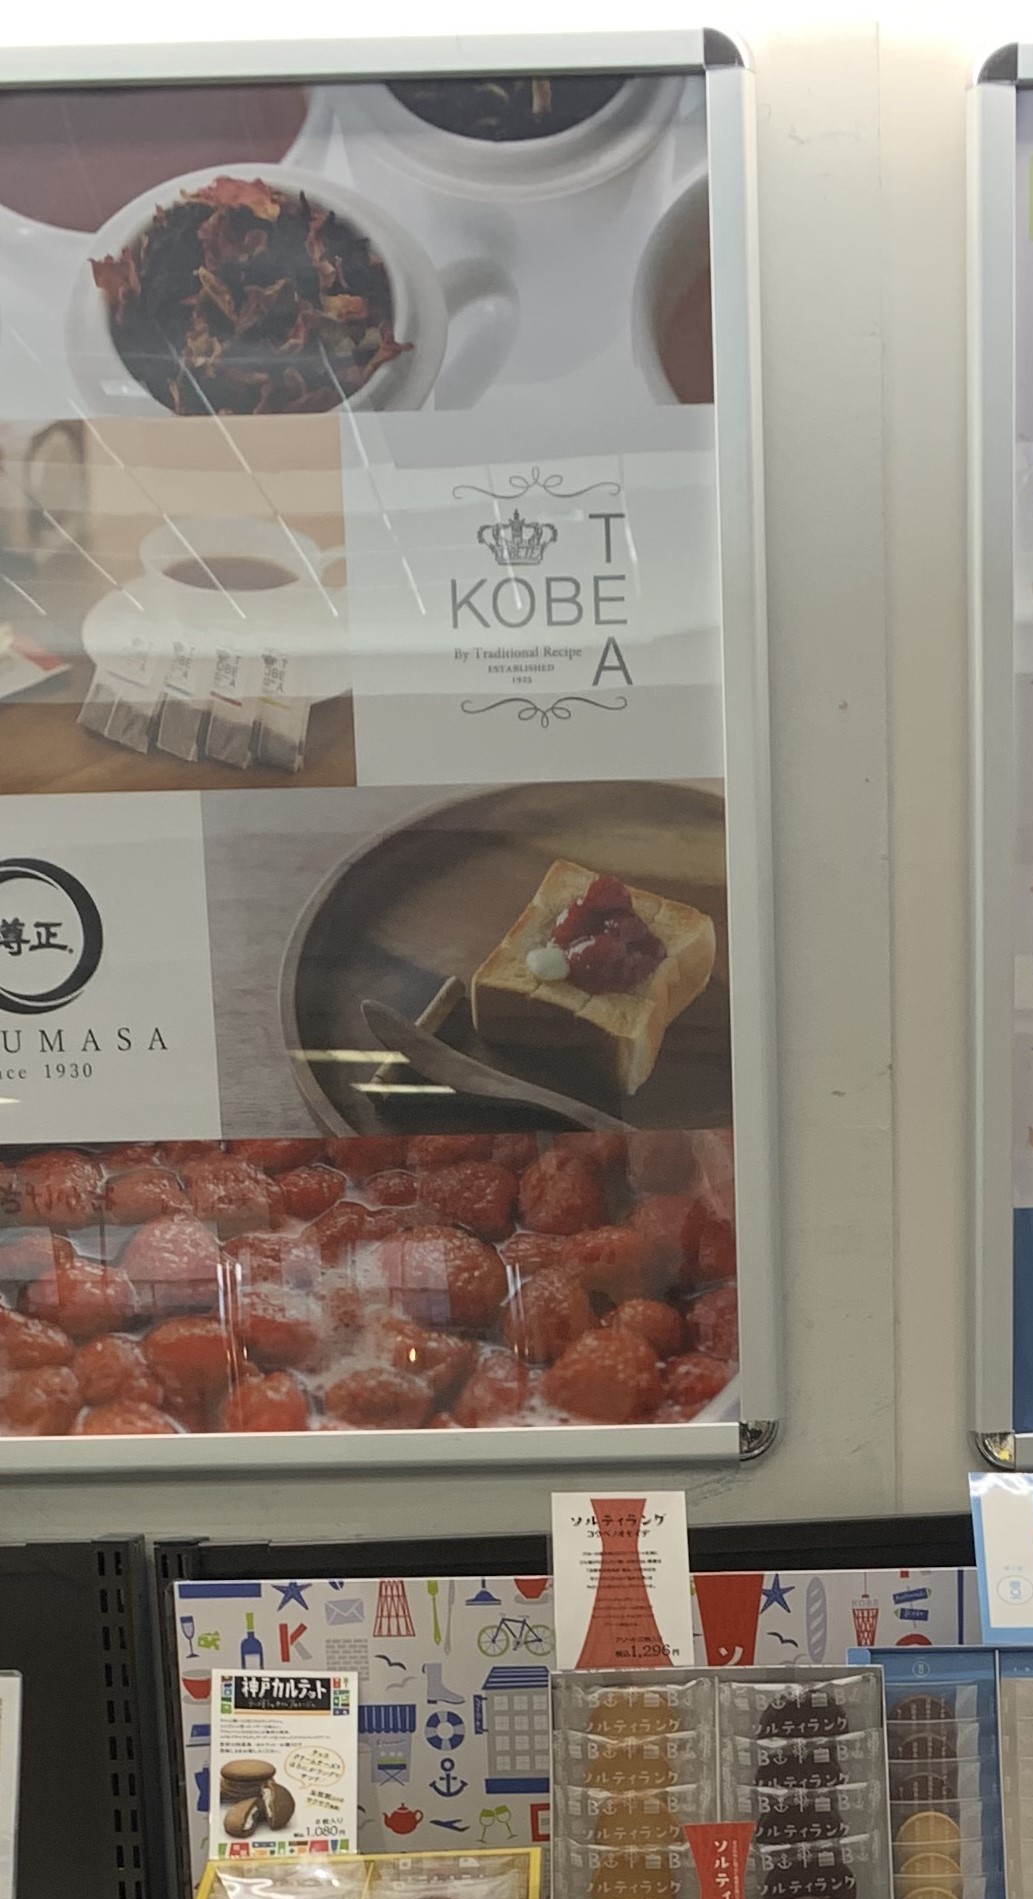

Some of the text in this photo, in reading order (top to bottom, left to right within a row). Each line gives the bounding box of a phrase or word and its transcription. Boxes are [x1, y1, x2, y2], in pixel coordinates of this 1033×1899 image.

[451, 575, 627, 629] KOBE
[454, 646, 582, 661] By Traditional Recipe
[488, 664, 555, 674] ESTABLISHED
[44, 1063, 93, 1079] 1930
[571, 1514, 666, 1527] ソルティラング
[242, 1676, 328, 1700] 神戸カルテット
